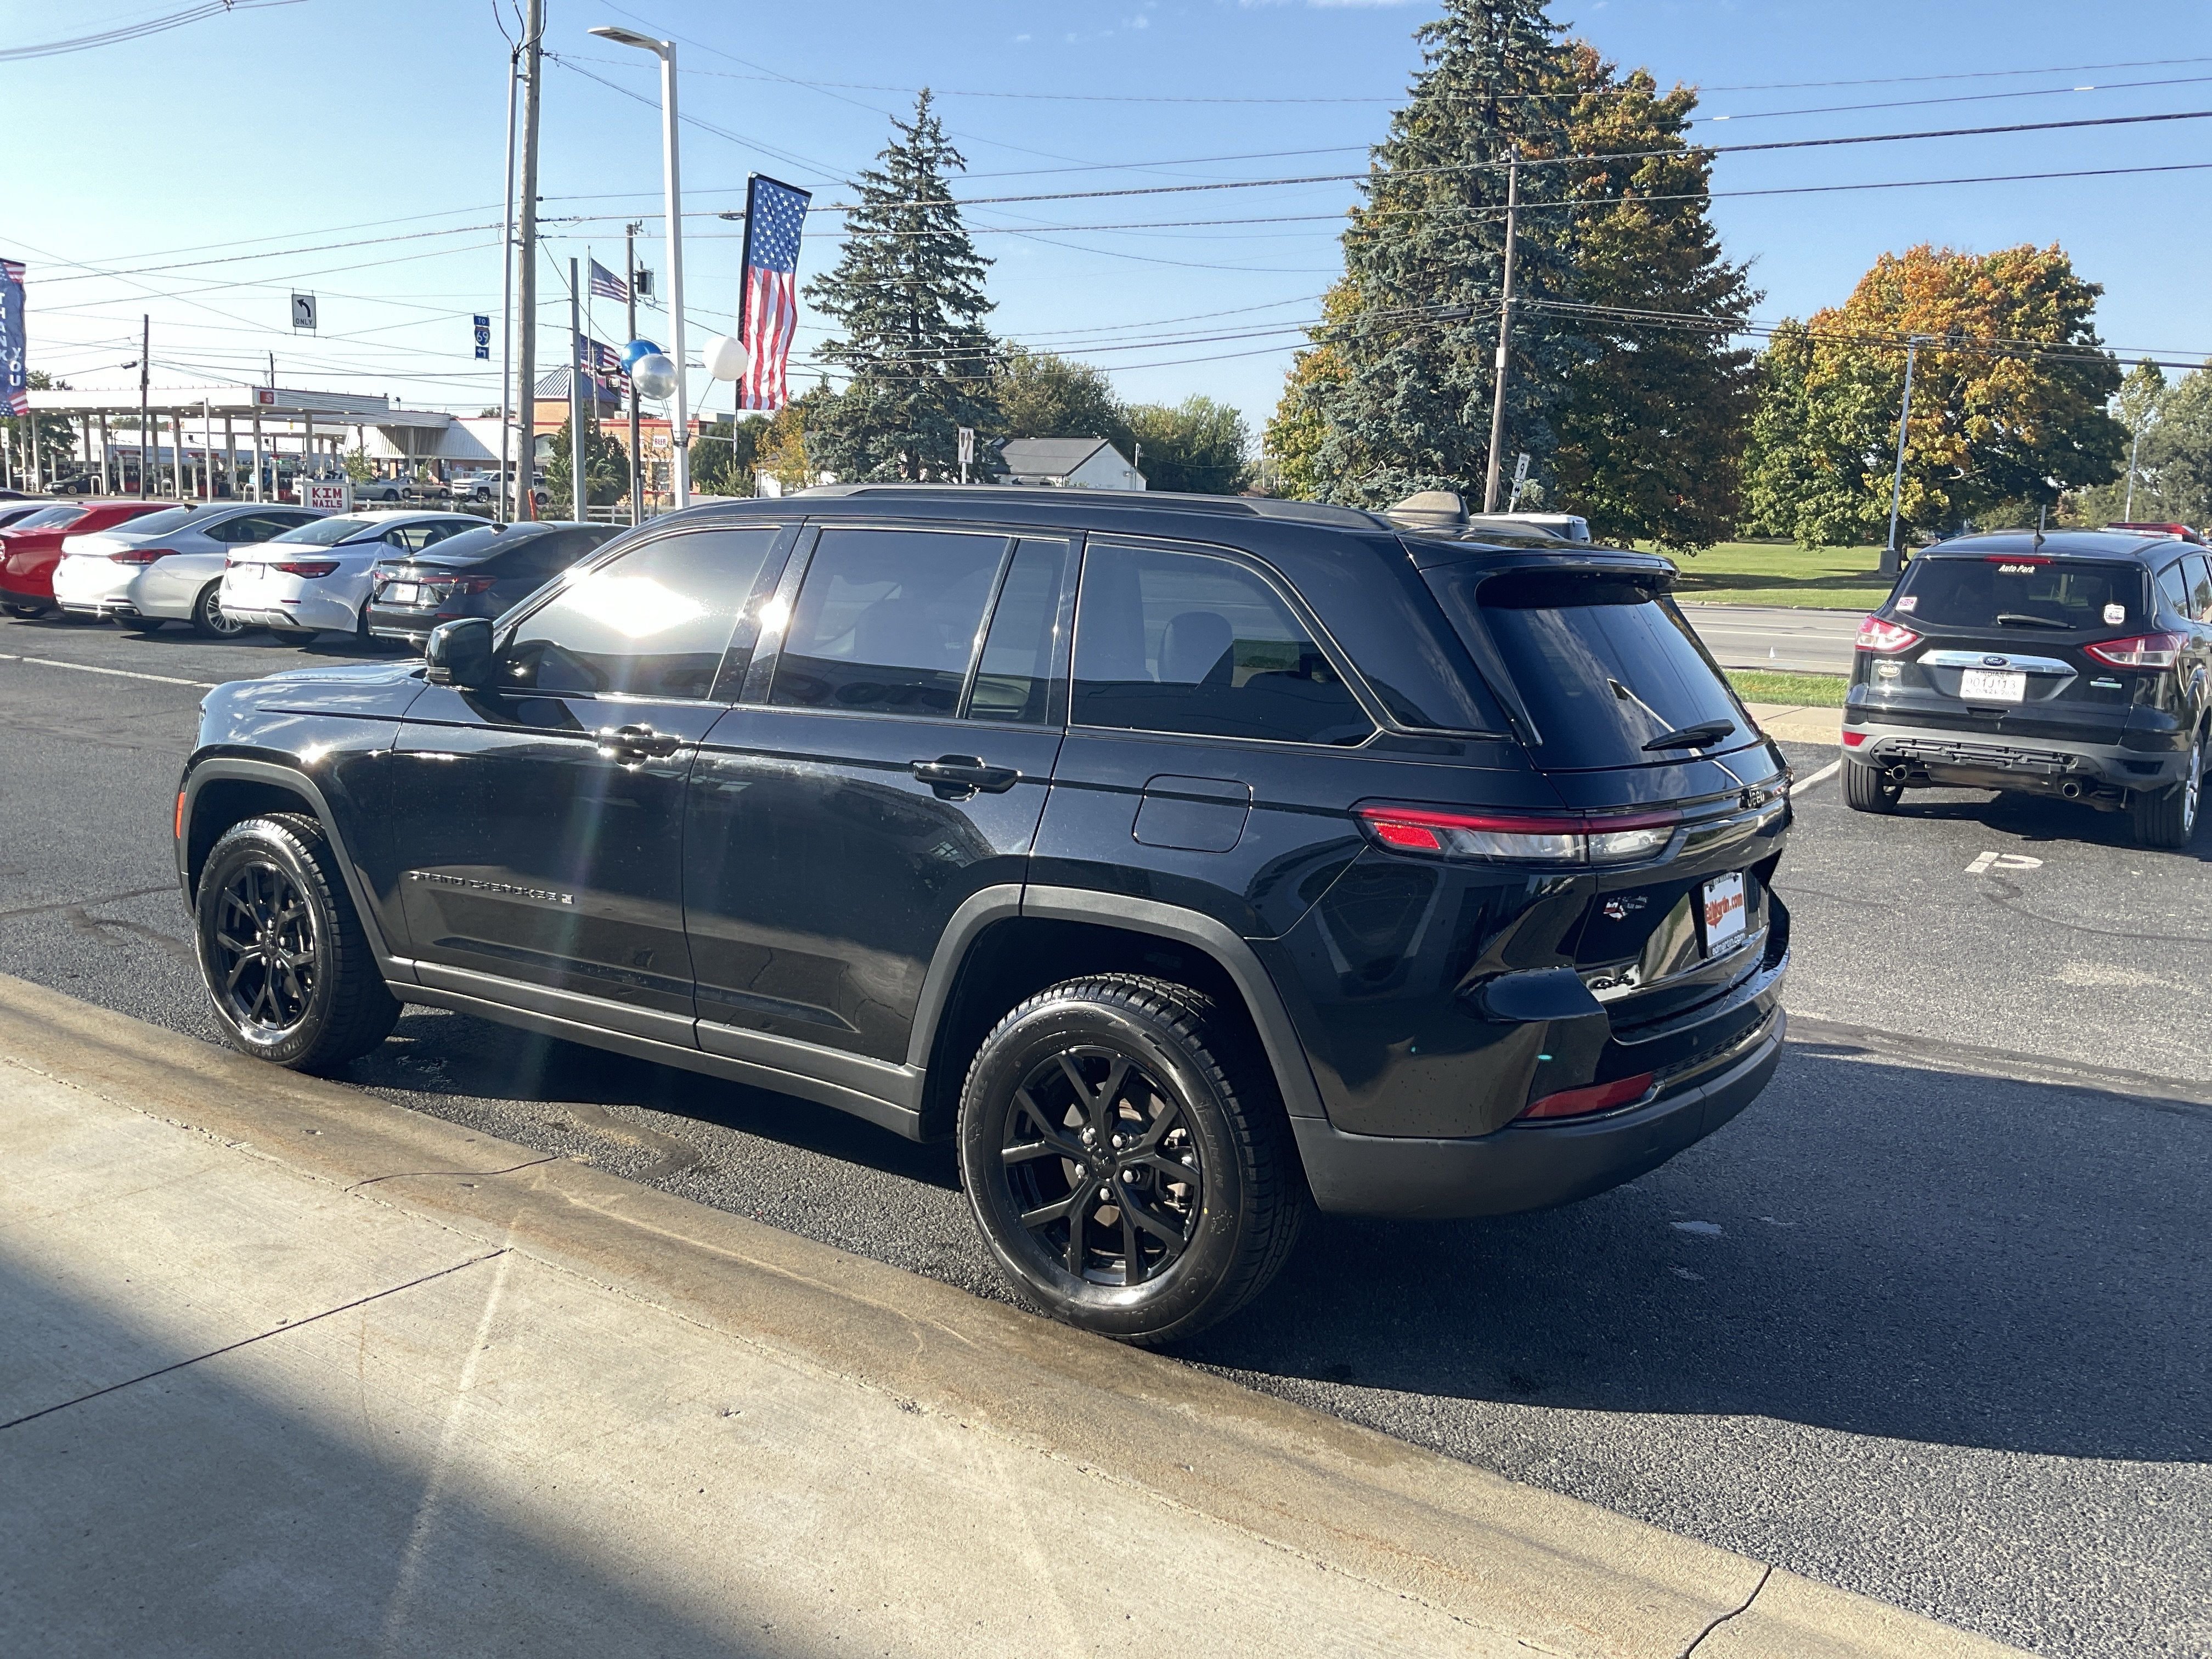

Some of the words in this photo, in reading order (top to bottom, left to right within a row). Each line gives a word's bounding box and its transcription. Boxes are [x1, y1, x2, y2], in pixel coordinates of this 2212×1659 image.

[296, 318, 313, 326] ONLY
[477, 331, 489, 342] 69
[9, 347, 21, 386] YOU
[1520, 462, 1525, 476] 9
[312, 487, 342, 498] KIM
[312, 500, 342, 508] NAILS
[1712, 933, 1745, 955] edmartin.com
